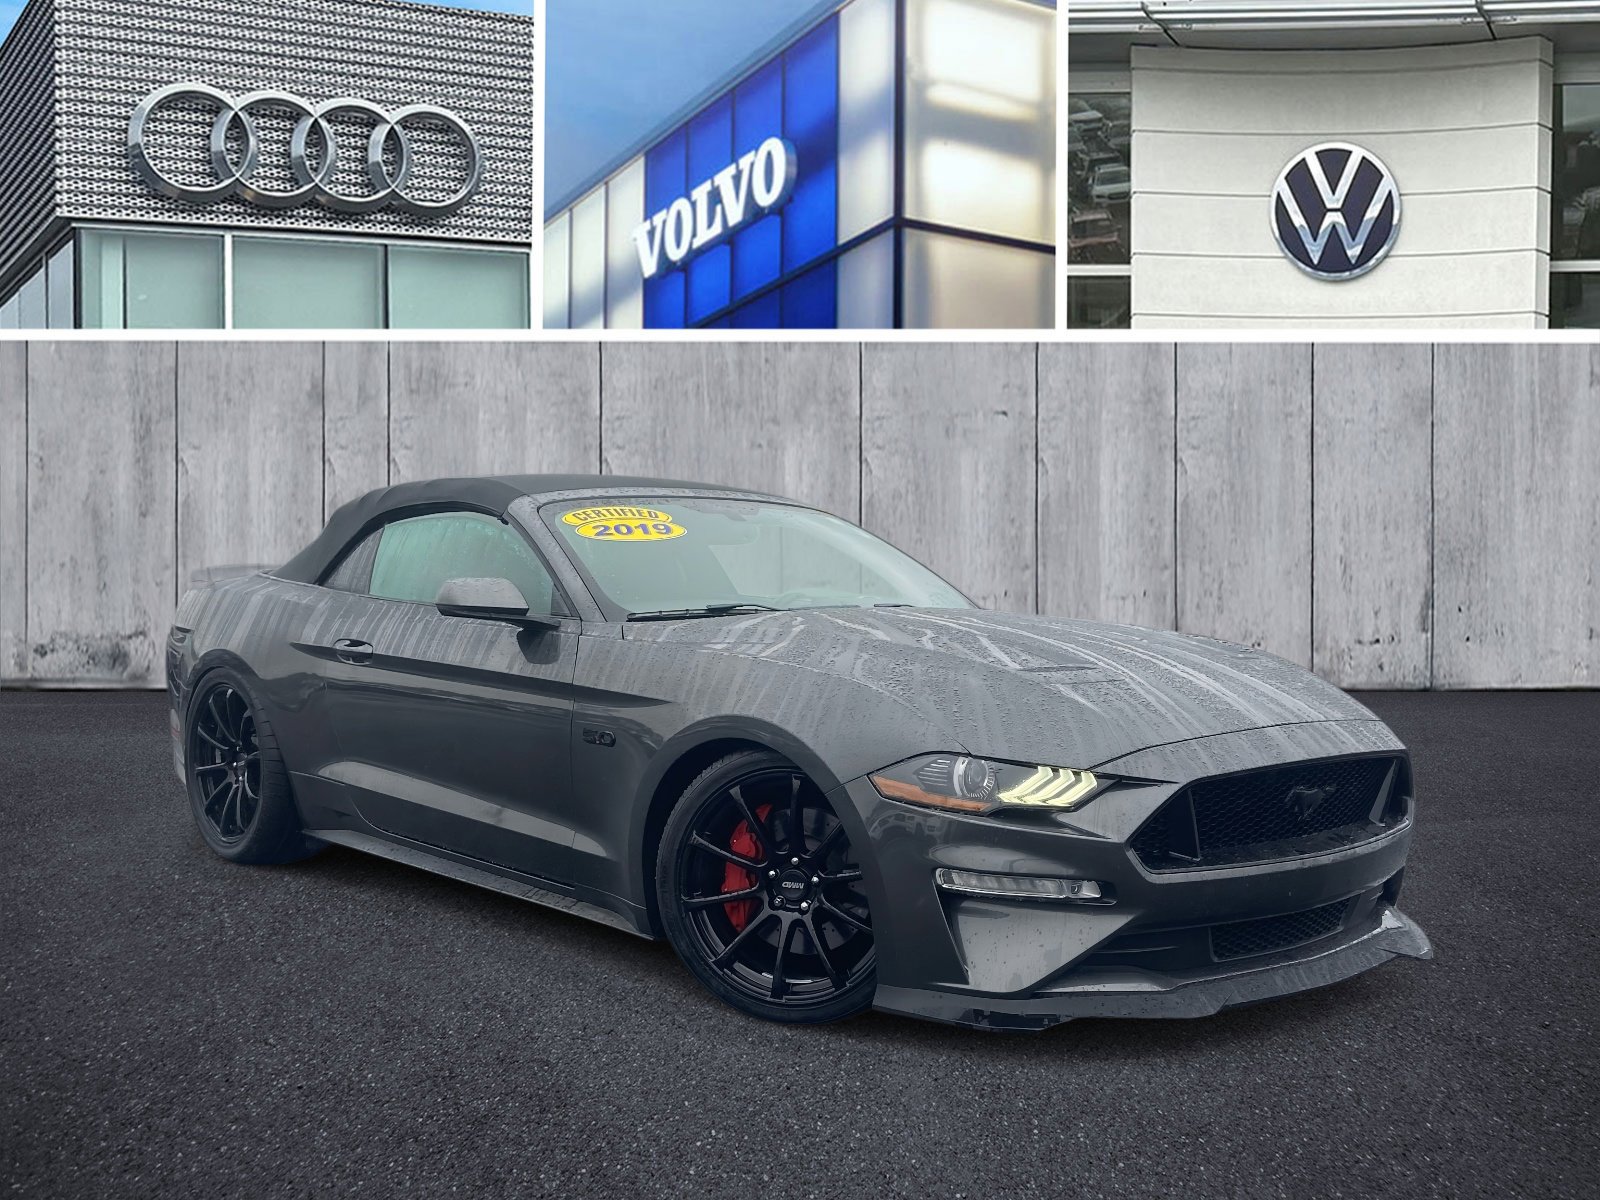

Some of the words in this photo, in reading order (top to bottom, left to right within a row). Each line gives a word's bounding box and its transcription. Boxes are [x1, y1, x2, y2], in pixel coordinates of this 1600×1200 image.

[633, 136, 790, 279] VOLVO
[572, 508, 660, 521] CERTIFIED
[592, 523, 674, 537] 2019
